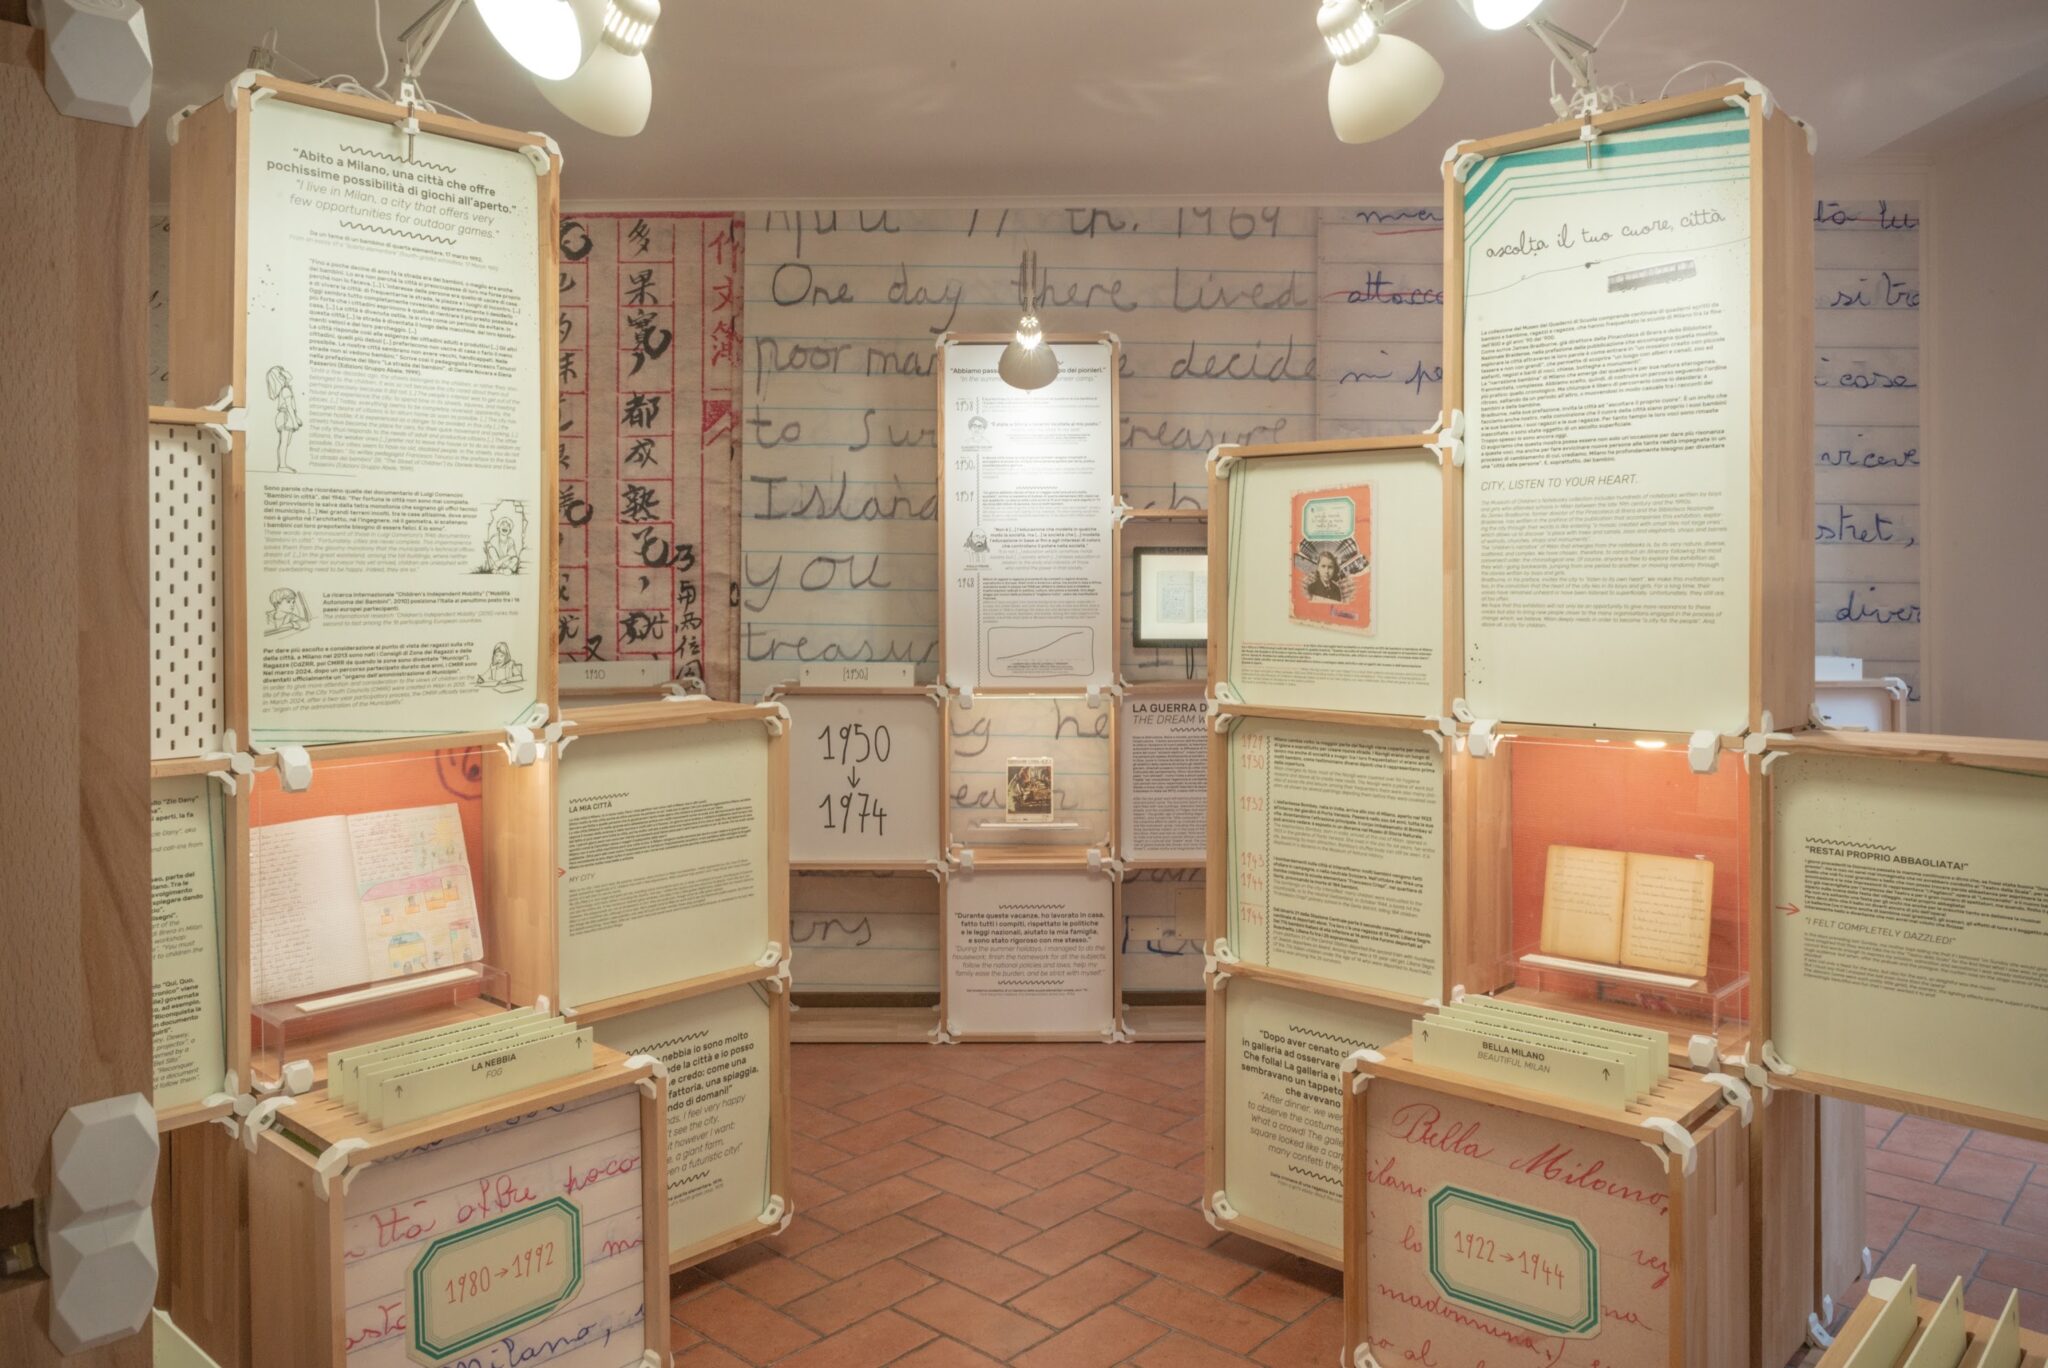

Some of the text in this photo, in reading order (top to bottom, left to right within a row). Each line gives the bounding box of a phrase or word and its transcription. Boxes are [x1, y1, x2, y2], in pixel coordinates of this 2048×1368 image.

[292, 147, 495, 196] "Abito a Milano, una città che offre
[266, 160, 516, 214] pochissime possibilità di giochi all'aperto."
[295, 178, 496, 226] "I live in Milan, a city that offers very
[289, 193, 500, 240] few opportunities for outdoor games."
[1557, 224, 1574, 249] il
[1582, 228, 1612, 244] tuo
[1680, 208, 1725, 228] città
[772, 263, 854, 306] One
[888, 261, 962, 334] day
[981, 367, 1001, 375] pass
[1480, 472, 1638, 491] CITY, LISTEN TO YOUR HEART.
[744, 555, 892, 612] you
[1132, 702, 1198, 714] LA GUERRA
[1132, 713, 1195, 725] THE DREAM
[818, 724, 890, 764] 1950
[568, 800, 612, 813] LA MIA CITTÀ
[818, 793, 887, 836] 1974
[1804, 845, 1968, 870] "RESTAI PROPRIO ABBAGLIATA!"
[1804, 916, 1956, 944] "I FELT COMPLETELY DAZZLED!"
[662, 1031, 748, 1062] nebbia io sono molto
[682, 1043, 754, 1069] la città e io posso
[1242, 1038, 1340, 1069] in galleria ad osservare
[1259, 1029, 1285, 1043] "Dopo
[1286, 1037, 1306, 1048] aver
[1308, 1043, 1339, 1057] cenato
[1482, 1040, 1544, 1061] BELLA MILANO
[471, 1052, 516, 1071] LA NEBBIA
[485, 1067, 502, 1080] FOG
[678, 1056, 746, 1083] credo: come una
[1244, 1050, 1260, 1061] Che
[1262, 1055, 1282, 1067] folla!
[1283, 1060, 1294, 1071] La
[1296, 1065, 1328, 1079] galleria
[1476, 1050, 1550, 1073] BEAUTIFUL MILAN
[668, 1066, 758, 1099] fattoria, una spiaggia,
[1241, 1064, 1343, 1096] sembravano un tappeto
[1286, 1087, 1340, 1108] che avevano
[1392, 1103, 1495, 1159] Bella
[445, 1242, 554, 1304] 1980 1992
[1454, 1230, 1565, 1290] 1922 1944
